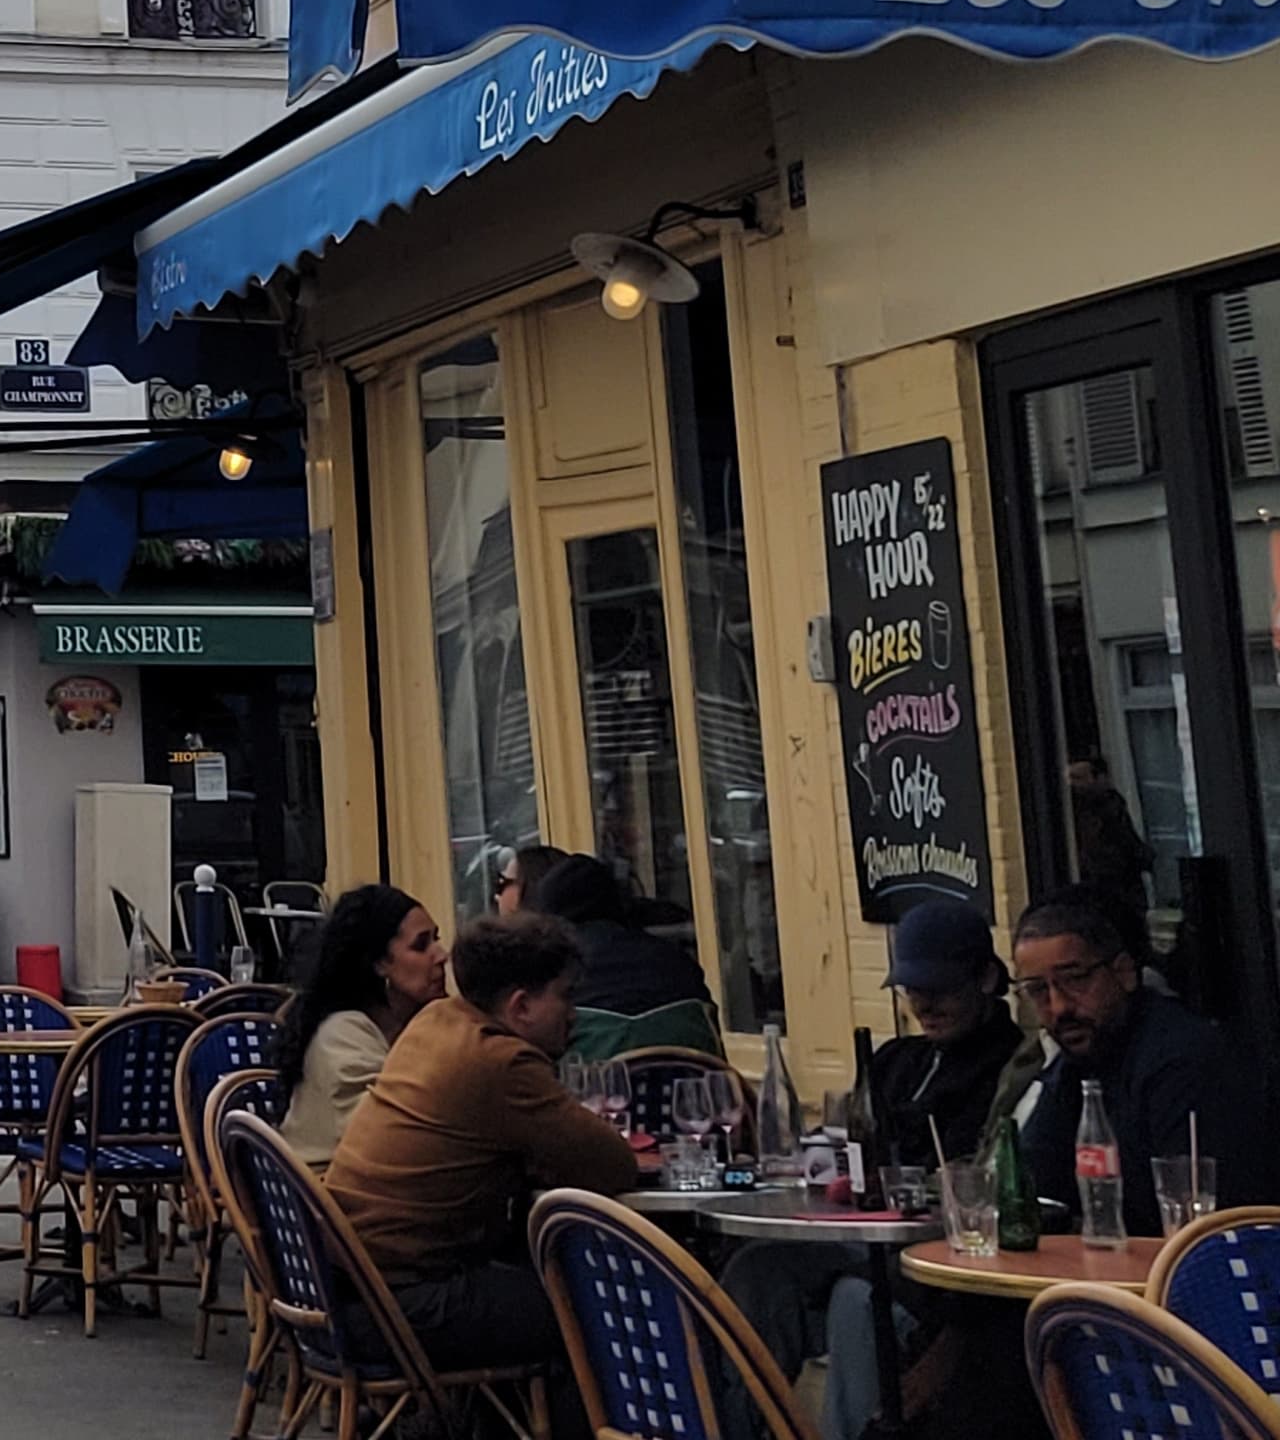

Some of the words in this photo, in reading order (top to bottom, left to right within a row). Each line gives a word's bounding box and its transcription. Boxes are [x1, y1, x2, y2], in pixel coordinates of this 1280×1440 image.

[475, 79, 517, 151] Les
[20, 341, 47, 363] 83
[3, 390, 84, 404] CHAMPIONNET
[31, 376, 56, 387] RUE
[831, 479, 901, 546] HAPPY
[865, 530, 935, 600] HOUR
[55, 625, 204, 653] BRASSERIE
[889, 753, 947, 829] Softs
